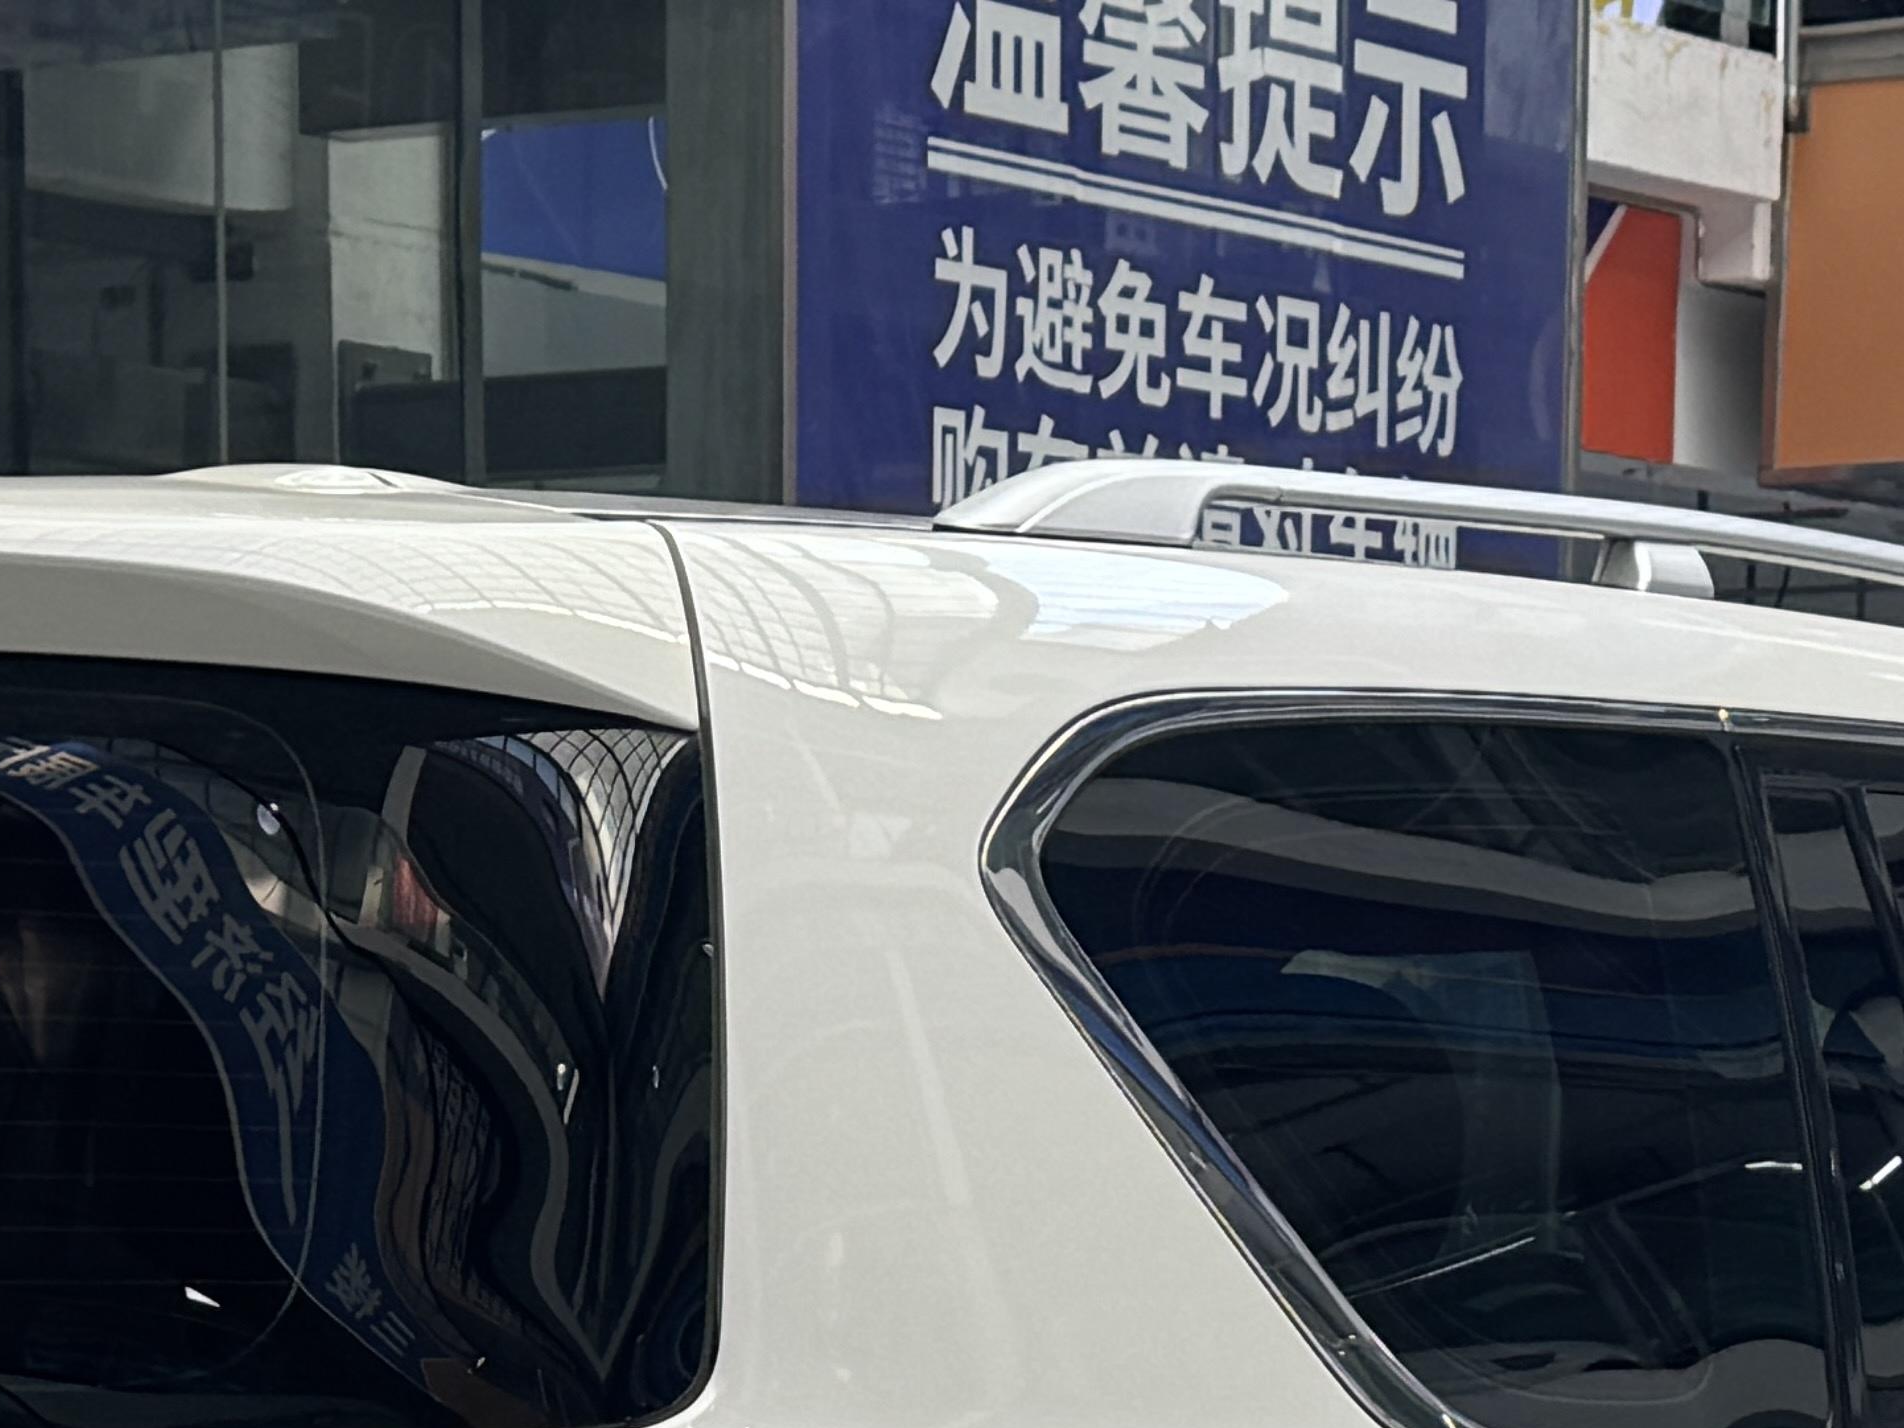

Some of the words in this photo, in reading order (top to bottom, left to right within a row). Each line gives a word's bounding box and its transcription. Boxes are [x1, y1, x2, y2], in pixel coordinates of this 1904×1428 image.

[932, 225, 1464, 459] 为避免车况纠纷
